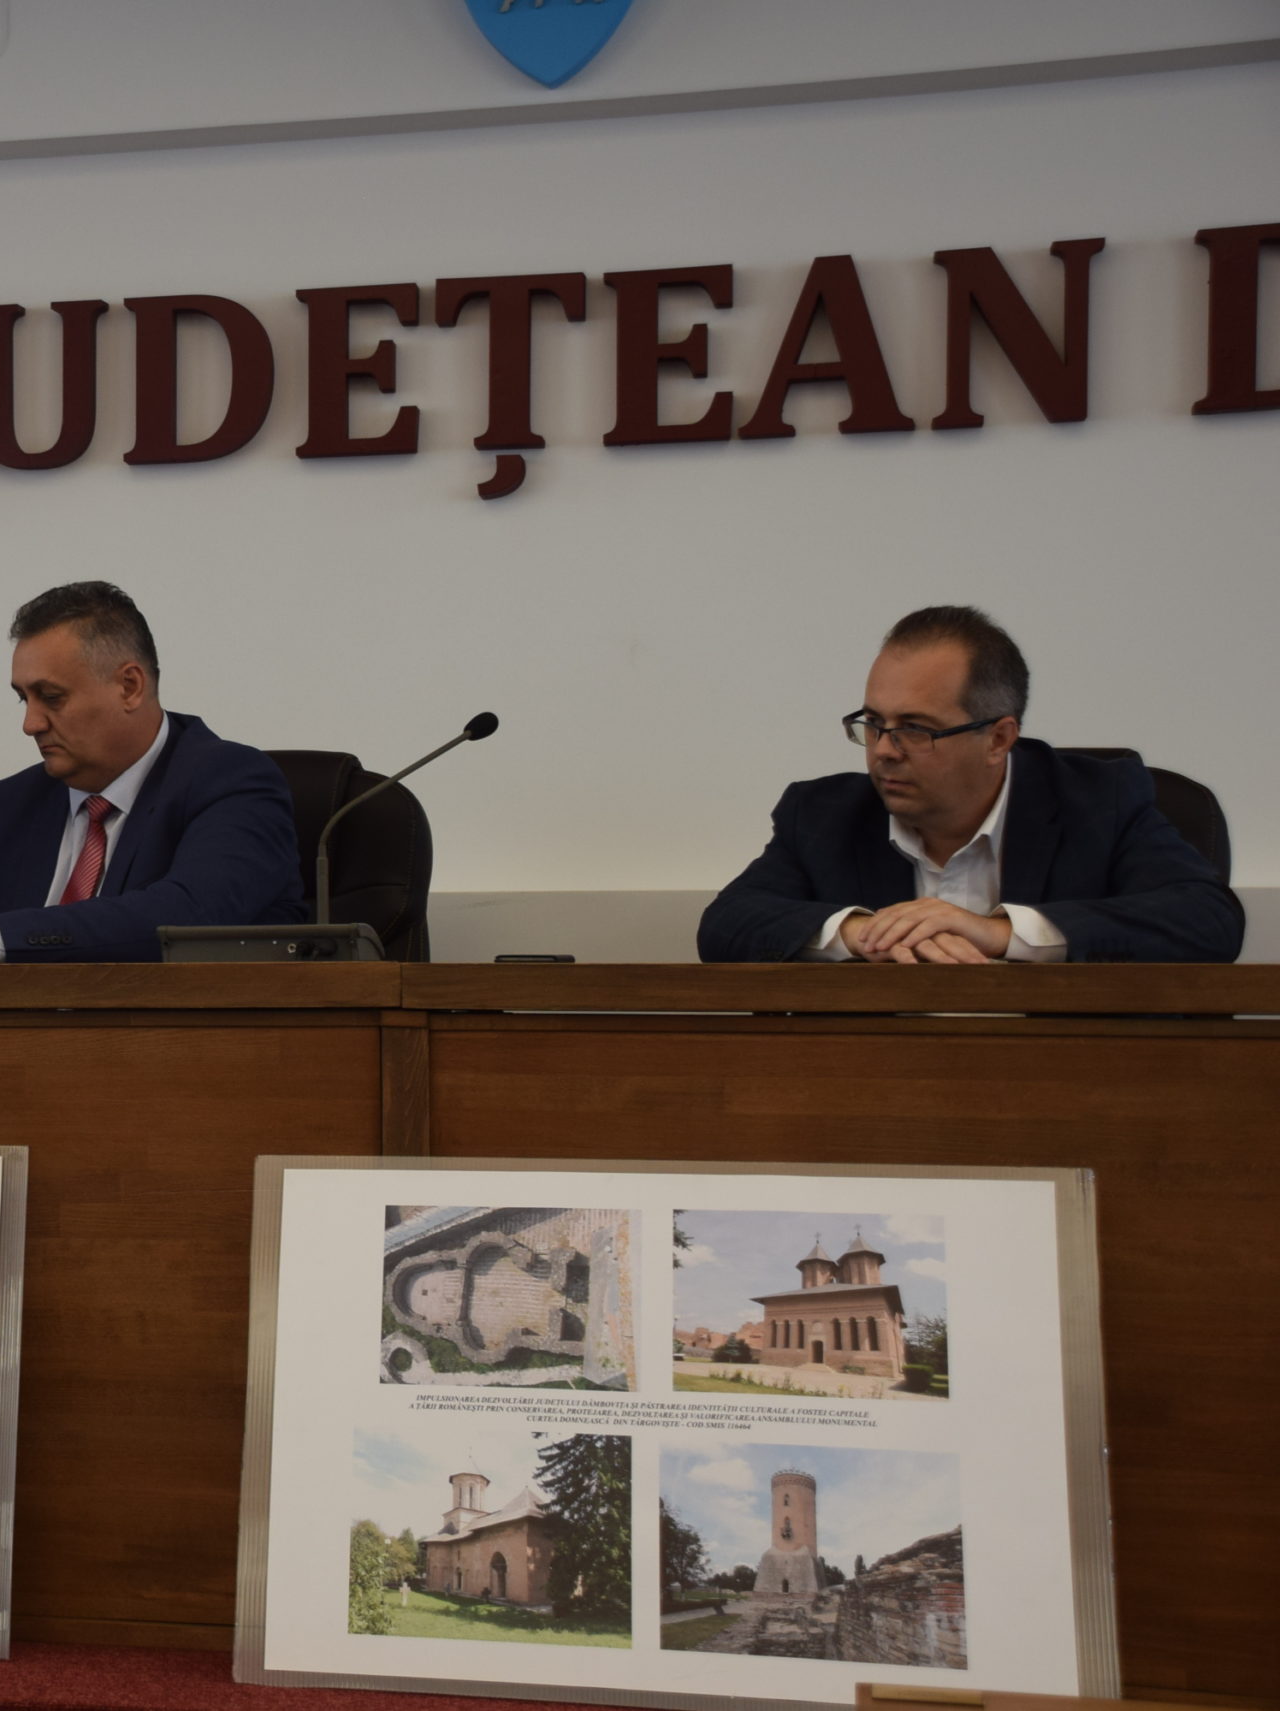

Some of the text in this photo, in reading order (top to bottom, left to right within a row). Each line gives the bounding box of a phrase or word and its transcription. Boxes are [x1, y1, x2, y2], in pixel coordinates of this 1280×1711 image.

[416, 1394, 480, 1403] IMPULSIONAREA
[481, 1396, 534, 1405] DEZVOLTĂRII
[640, 1401, 686, 1411] PĂSTRAREA
[739, 1406, 787, 1414] CULTURALE
[796, 1408, 827, 1416] FOSTEI
[828, 1409, 870, 1418] CAPITALE
[506, 1406, 564, 1415] CONSERVAREA,
[566, 1408, 620, 1417] PROTEJAREA,
[621, 1410, 679, 1419] DEZVOLTAREA
[690, 1412, 755, 1422] VALORIFICAREA
[757, 1415, 816, 1424] ANSAMBLULUI
[817, 1417, 878, 1427] MONUMENTAL
[559, 1416, 609, 1424] DOMNEASCĂ
